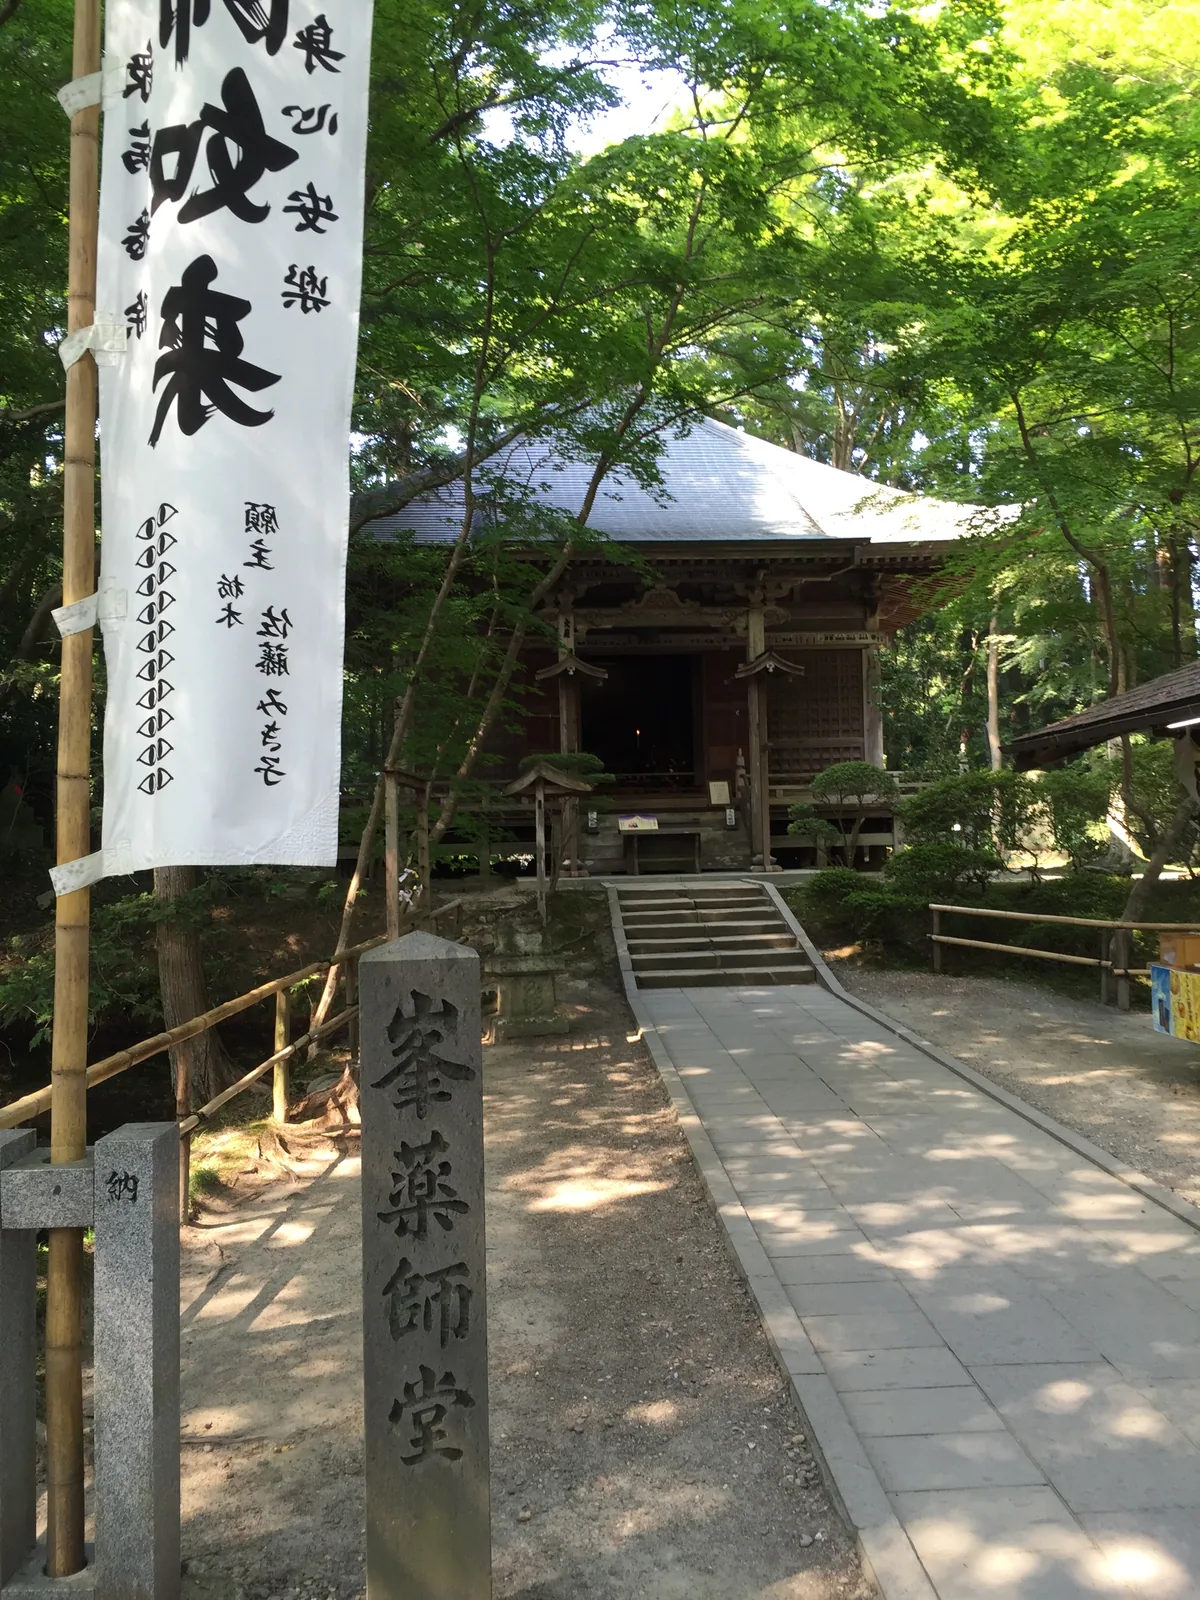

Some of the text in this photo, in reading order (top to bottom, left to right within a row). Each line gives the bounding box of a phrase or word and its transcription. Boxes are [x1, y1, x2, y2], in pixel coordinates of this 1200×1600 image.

[105, 1171, 140, 1203] 納
[370, 988, 477, 1467] 峯薬師堂
